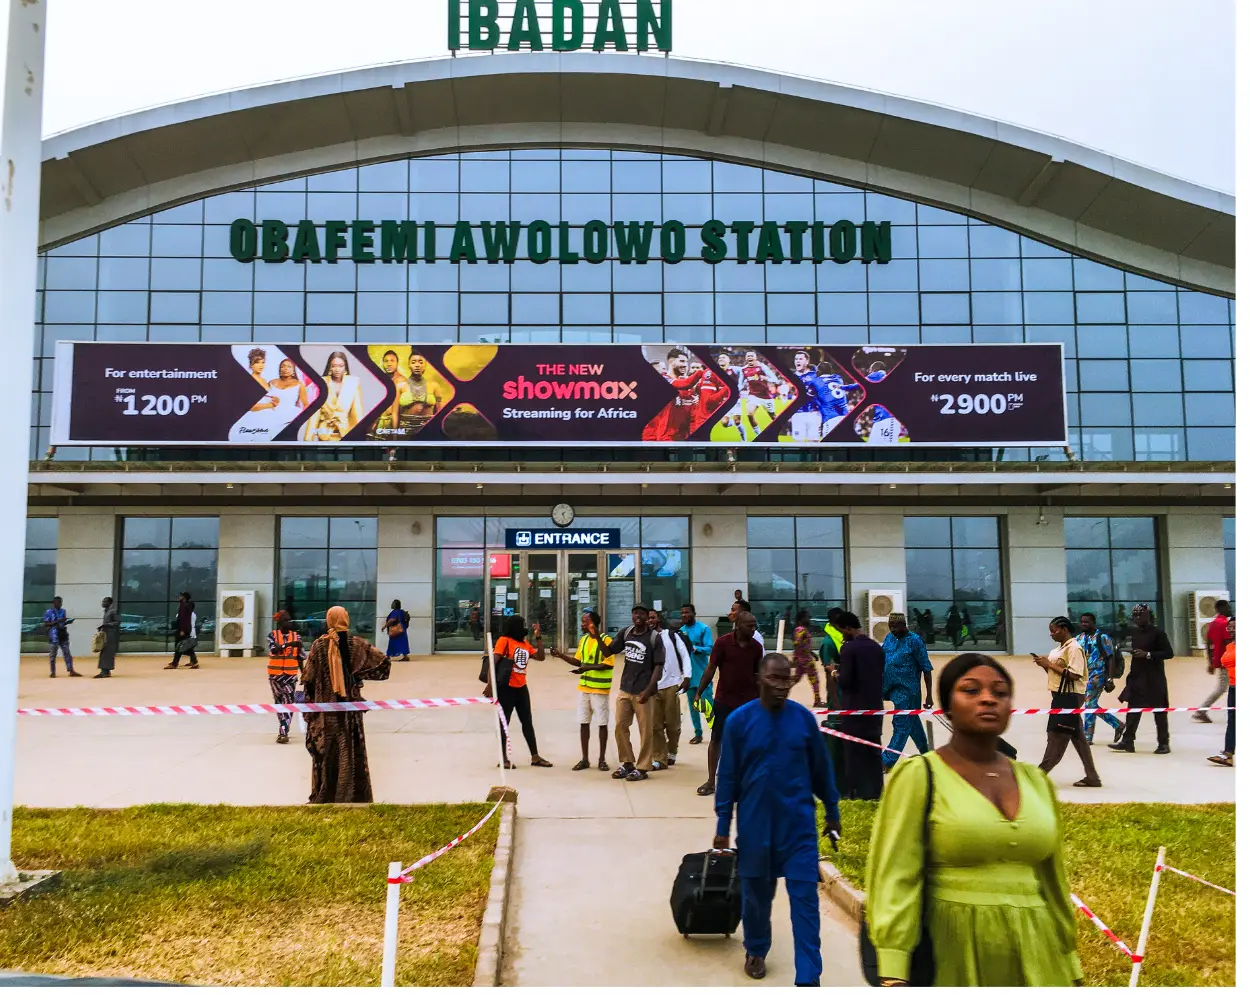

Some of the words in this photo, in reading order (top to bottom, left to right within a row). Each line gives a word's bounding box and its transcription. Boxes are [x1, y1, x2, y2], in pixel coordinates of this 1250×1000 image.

[448, 0, 673, 51] IBADAN
[230, 218, 436, 264] OBAFEMI
[450, 219, 686, 265] AWOLOWO
[700, 219, 892, 265] STATION
[105, 368, 126, 378] For
[128, 368, 217, 379] entertainment
[536, 364, 565, 375] THE
[569, 364, 604, 375] NEW
[914, 372, 934, 382] For
[938, 374, 971, 384] every
[974, 371, 1012, 382] match
[1014, 371, 1038, 382] live
[502, 375, 638, 400] showmax
[191, 395, 207, 403] PM
[1007, 393, 1024, 402] PM
[502, 407, 571, 421] Streaming
[574, 408, 595, 419] for
[597, 408, 638, 419] Africa
[534, 532, 610, 545] ENTRANCE
